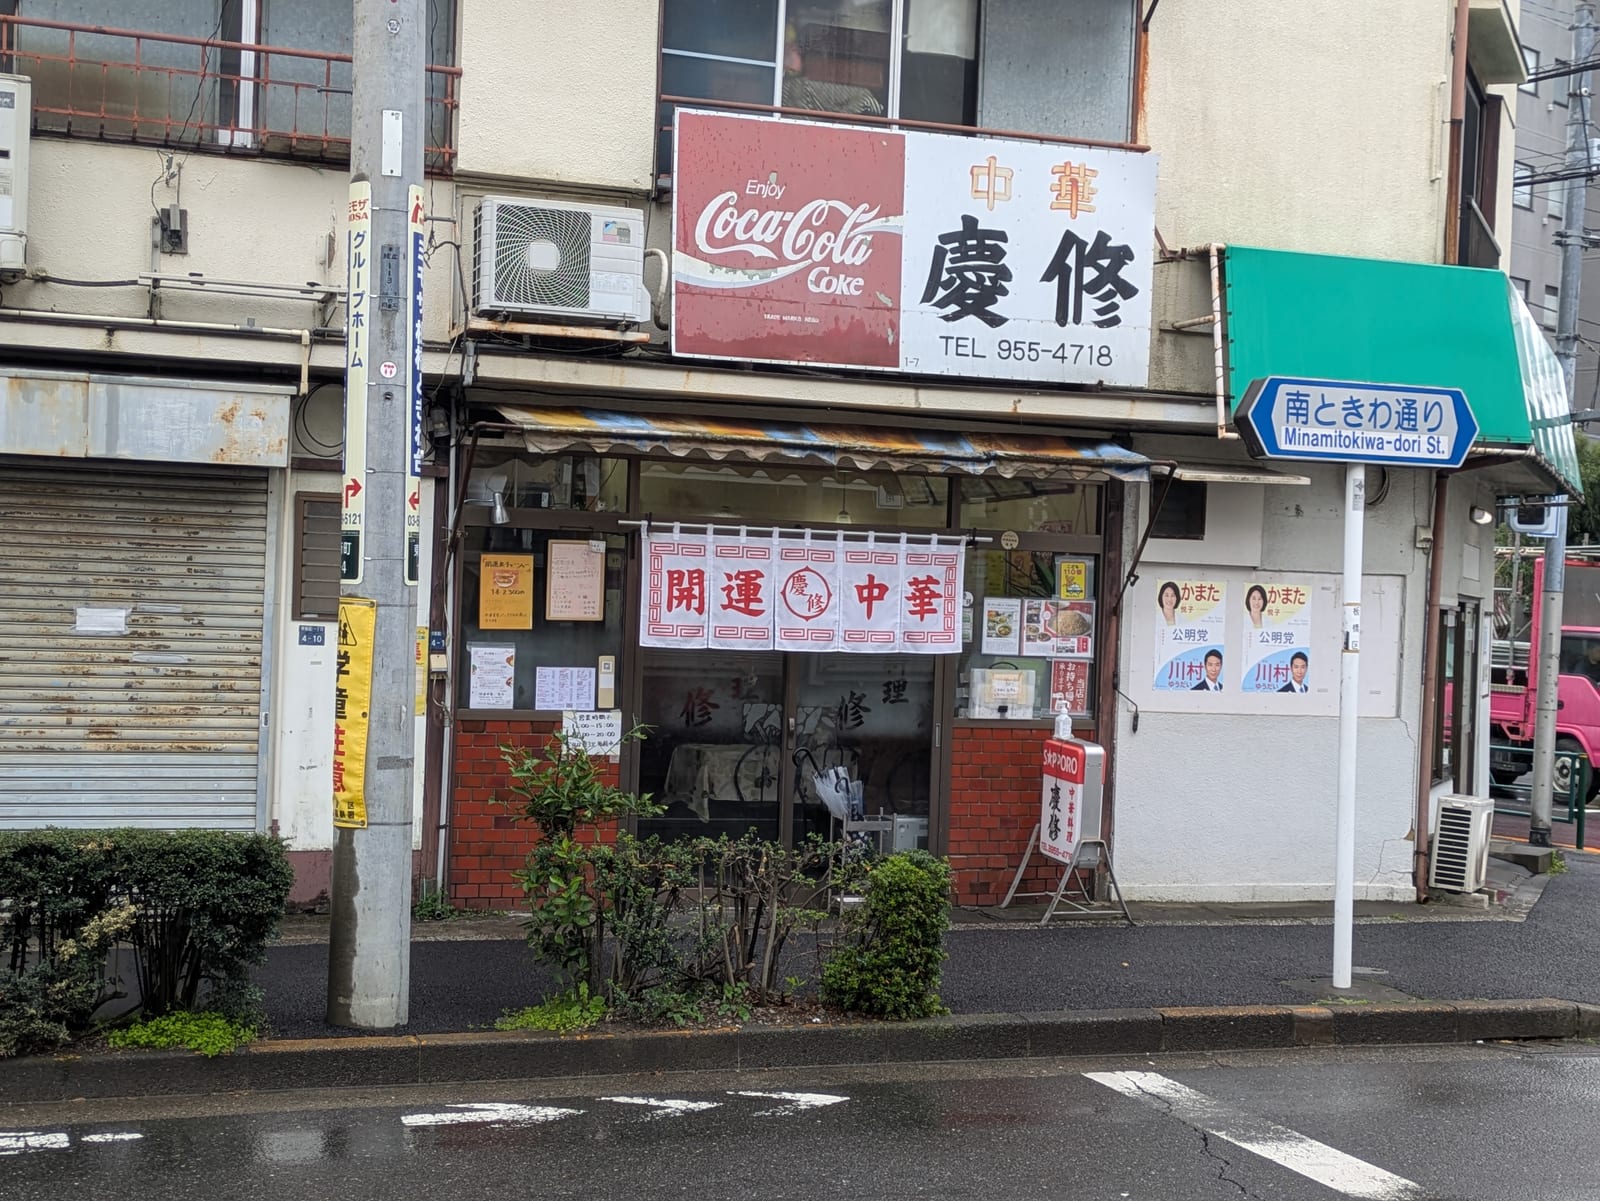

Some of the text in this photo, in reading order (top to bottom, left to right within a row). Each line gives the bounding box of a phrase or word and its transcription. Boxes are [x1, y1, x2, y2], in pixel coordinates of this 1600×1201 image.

[745, 179, 786, 200] Enjoy
[970, 155, 1099, 220] 中華
[695, 191, 881, 266] Coca-Cola
[807, 266, 865, 296] Coke
[919, 214, 1140, 329] 慶修
[352, 230, 367, 368] グループホーム
[904, 357, 920, 368] 1-7
[938, 335, 1113, 366] TEL 955-4718
[1285, 390, 1444, 433] 南ときわ通り
[1284, 427, 1446, 455] Minamitokiwa-dori St.
[666, 568, 943, 622] 開運 慶修 中華
[1181, 582, 1220, 602] かまた
[1267, 585, 1306, 605] かまた
[1172, 628, 1209, 642] 公明党
[1259, 631, 1295, 645] 公明党
[1168, 660, 1204, 681] 川村
[1255, 663, 1291, 683] 川村
[1048, 783, 1061, 841] 慶修
[1065, 787, 1075, 843] 中華料理
